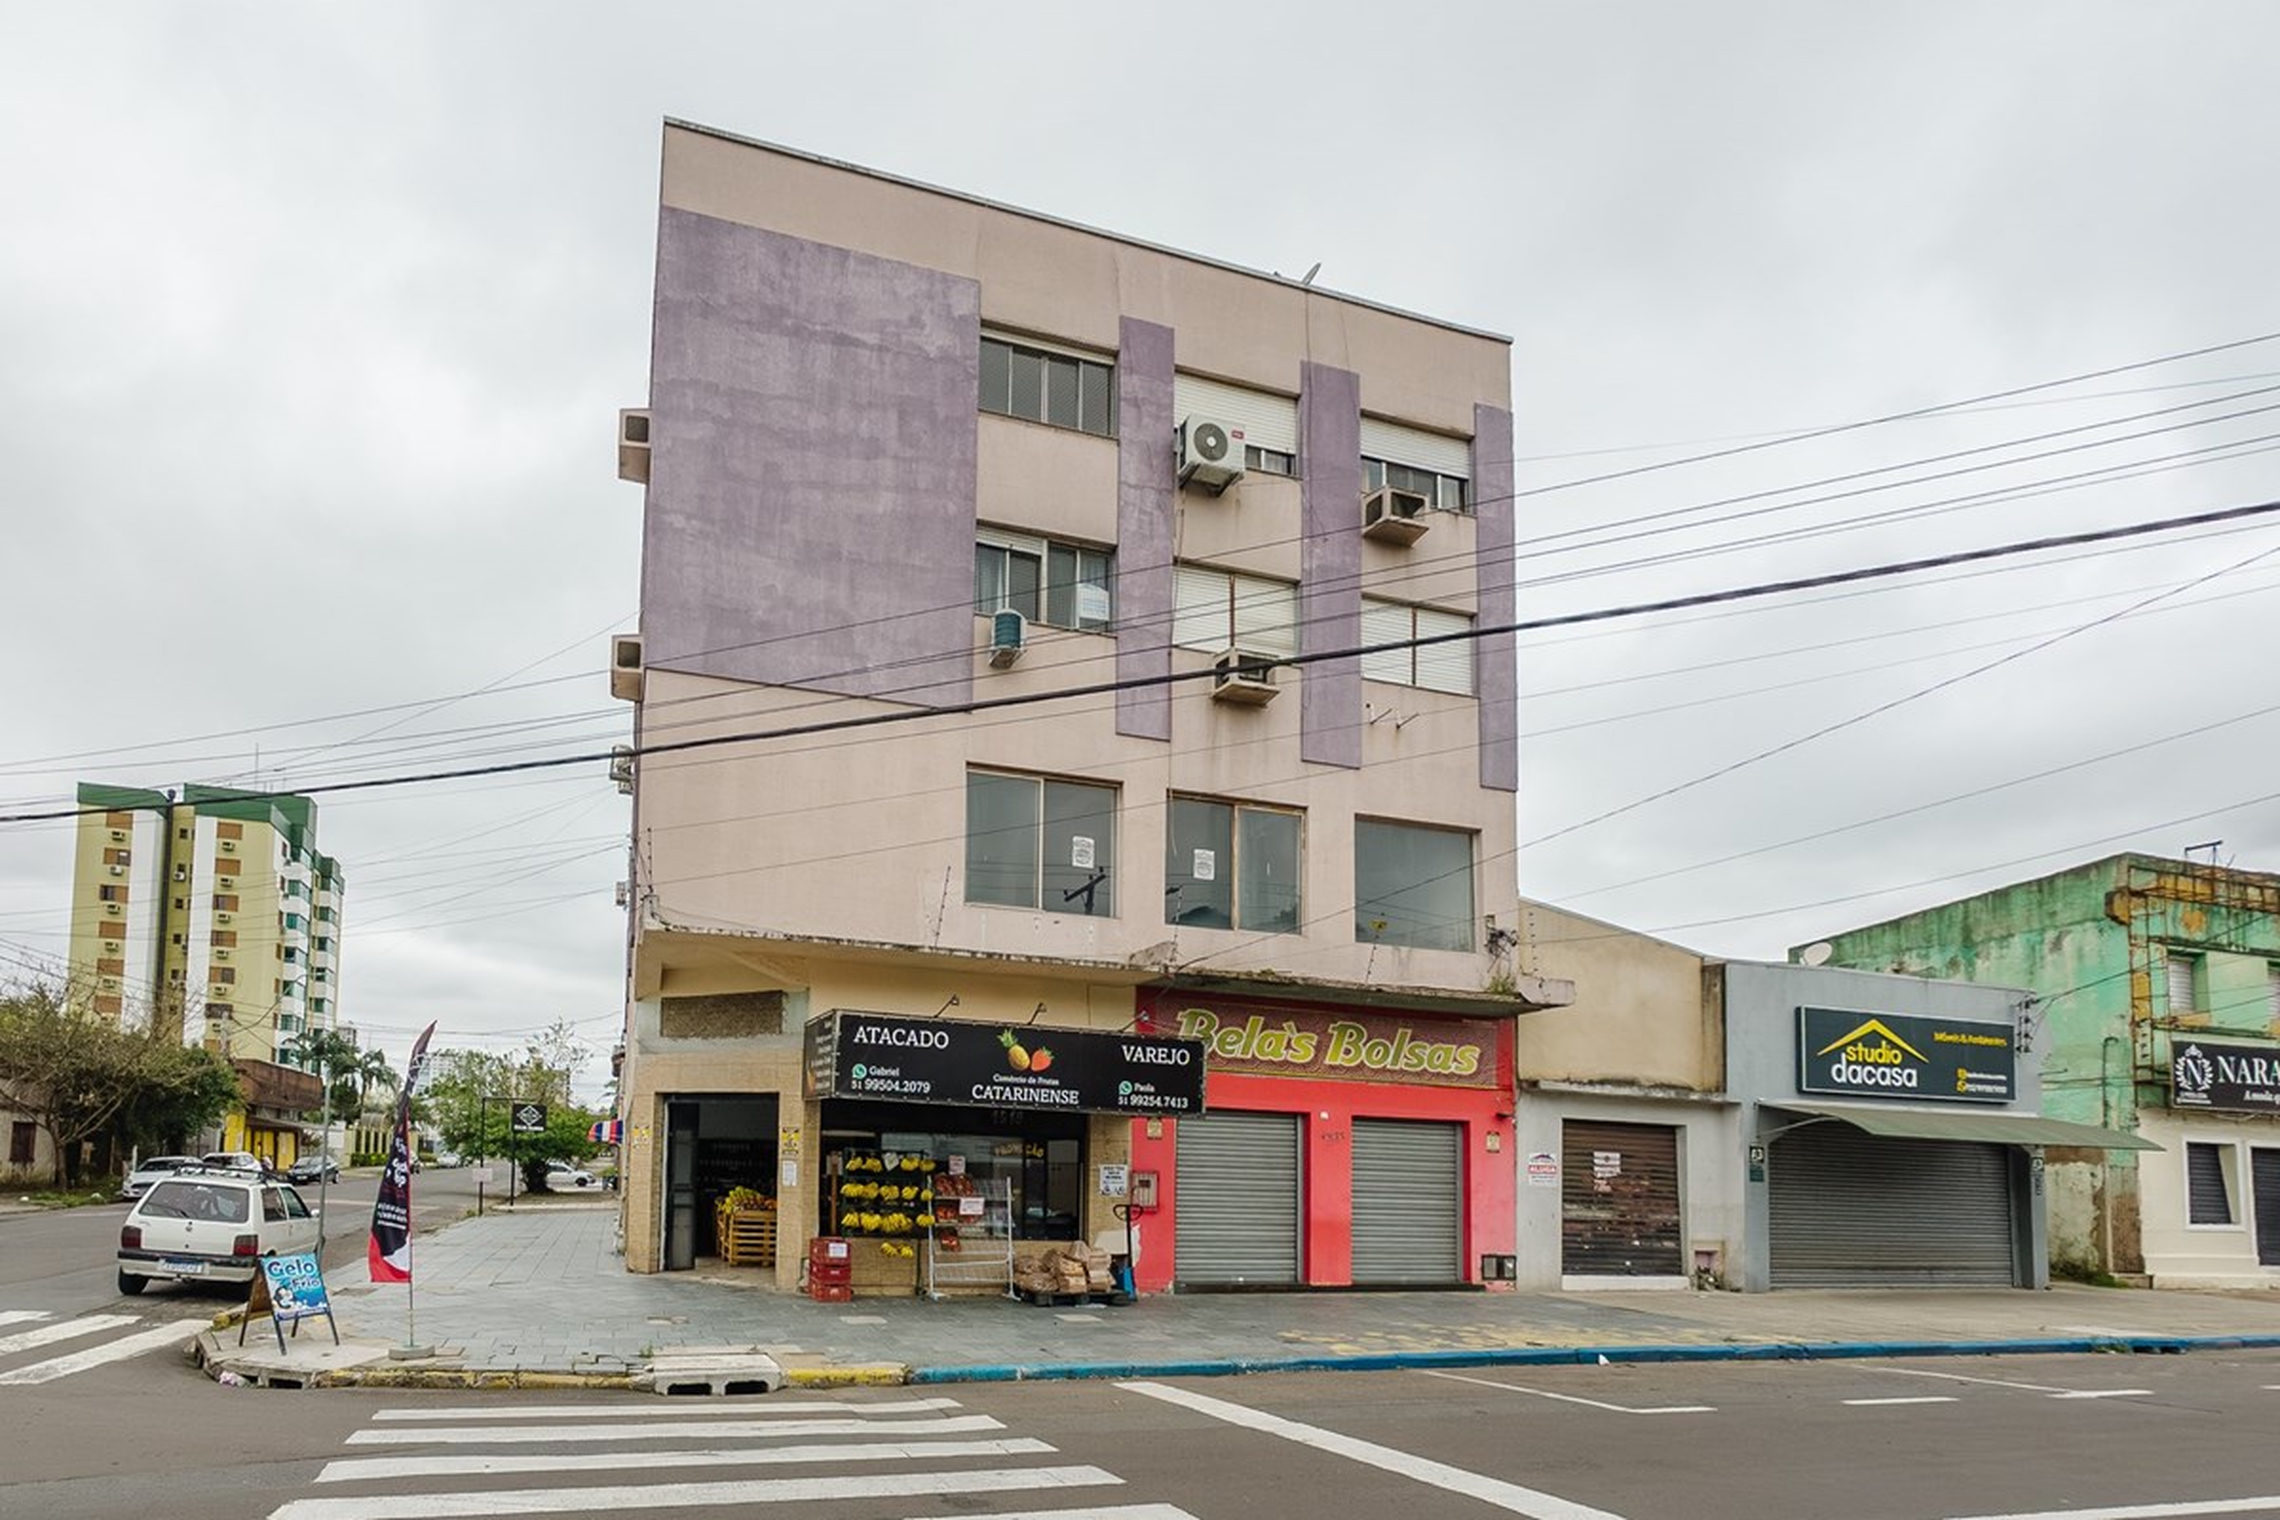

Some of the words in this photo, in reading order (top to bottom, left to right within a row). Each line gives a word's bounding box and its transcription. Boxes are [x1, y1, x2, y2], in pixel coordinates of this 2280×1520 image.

[853, 1025, 950, 1050] ATACADO
[1323, 1020, 1480, 1076] Bolsas
[1121, 1044, 1191, 1066] VAREJO
[1845, 1040, 1903, 1065] studio
[1830, 1053, 1919, 1088] dacasa
[971, 1083, 1080, 1105] CATARINENSE
[267, 1255, 316, 1279] Gelo
[291, 1276, 321, 1293] Frio
